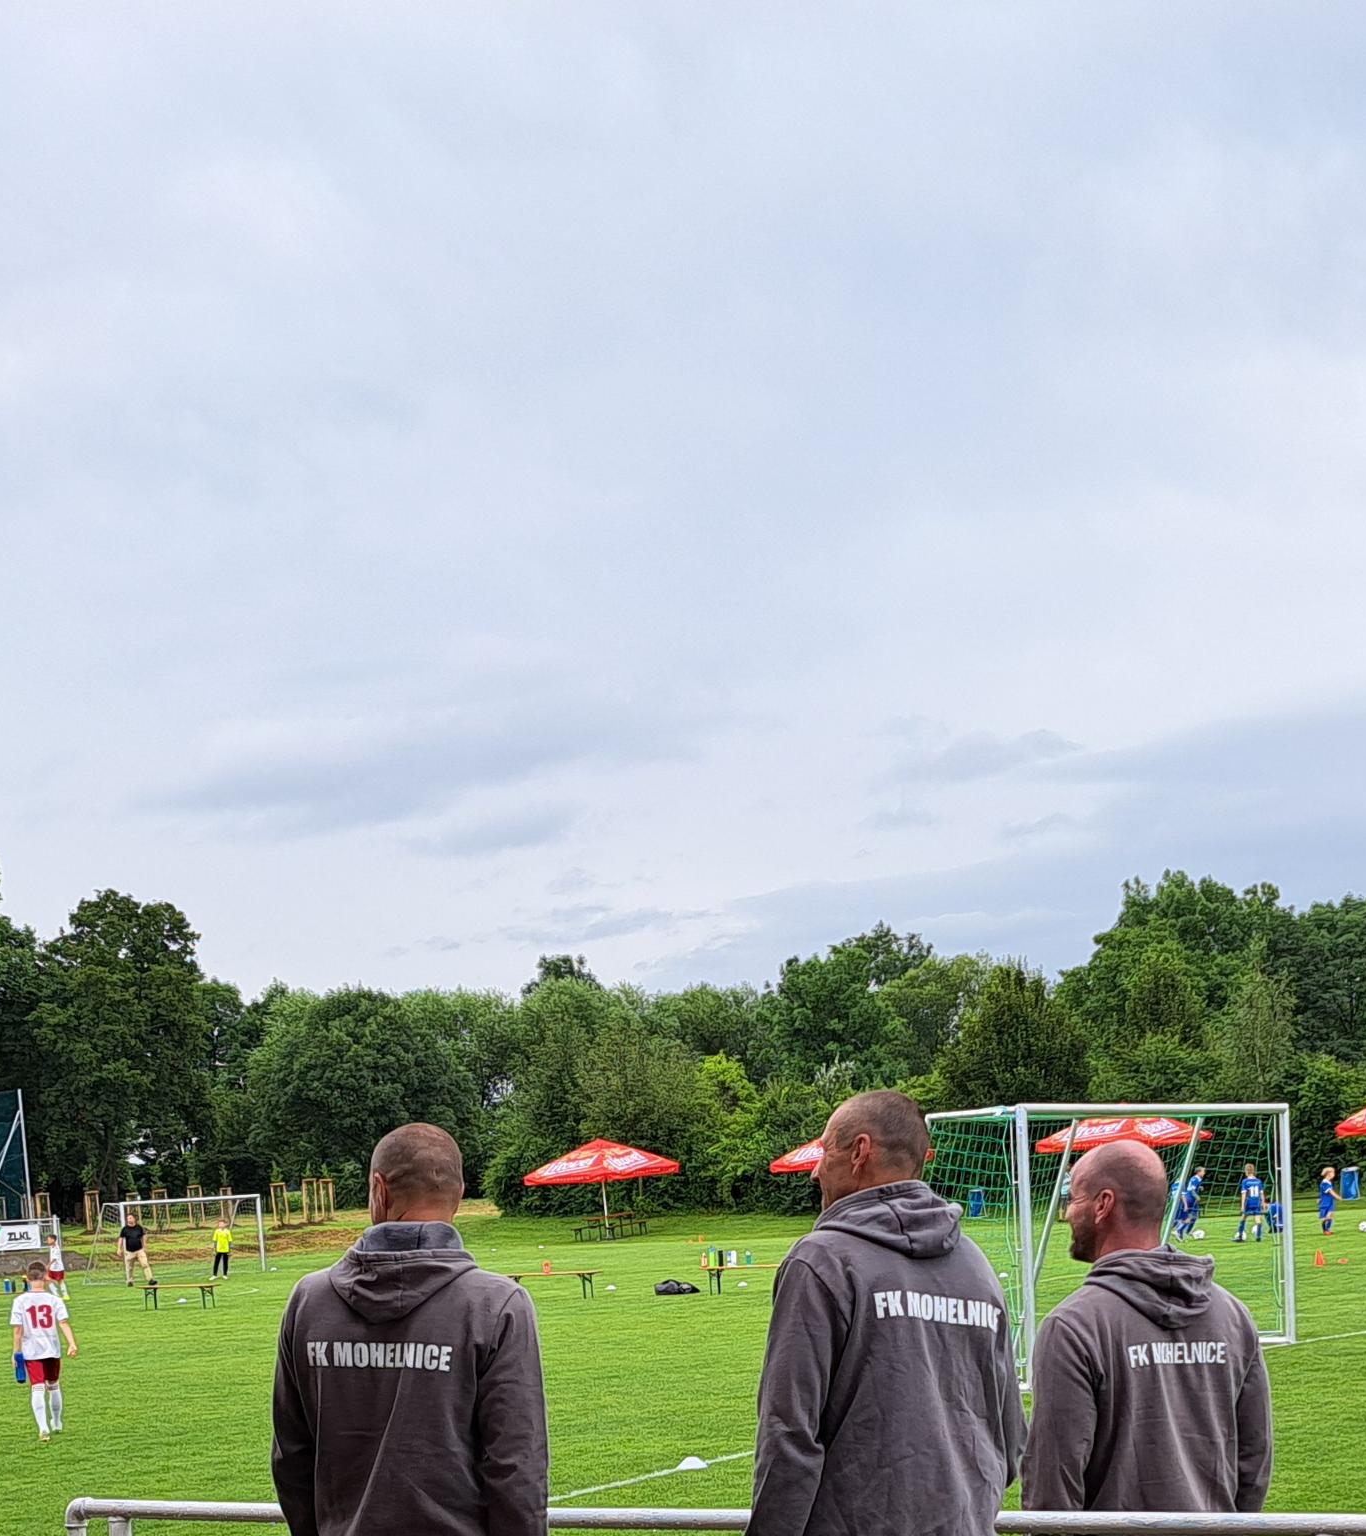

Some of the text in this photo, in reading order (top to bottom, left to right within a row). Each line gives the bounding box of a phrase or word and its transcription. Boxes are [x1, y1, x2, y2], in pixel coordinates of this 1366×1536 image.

[26, 1304, 53, 1329] 13
[873, 1290, 1001, 1334] FK MOHELNIC
[306, 1341, 453, 1372] FK MOHELNICE
[1127, 1343, 1150, 1369] FK
